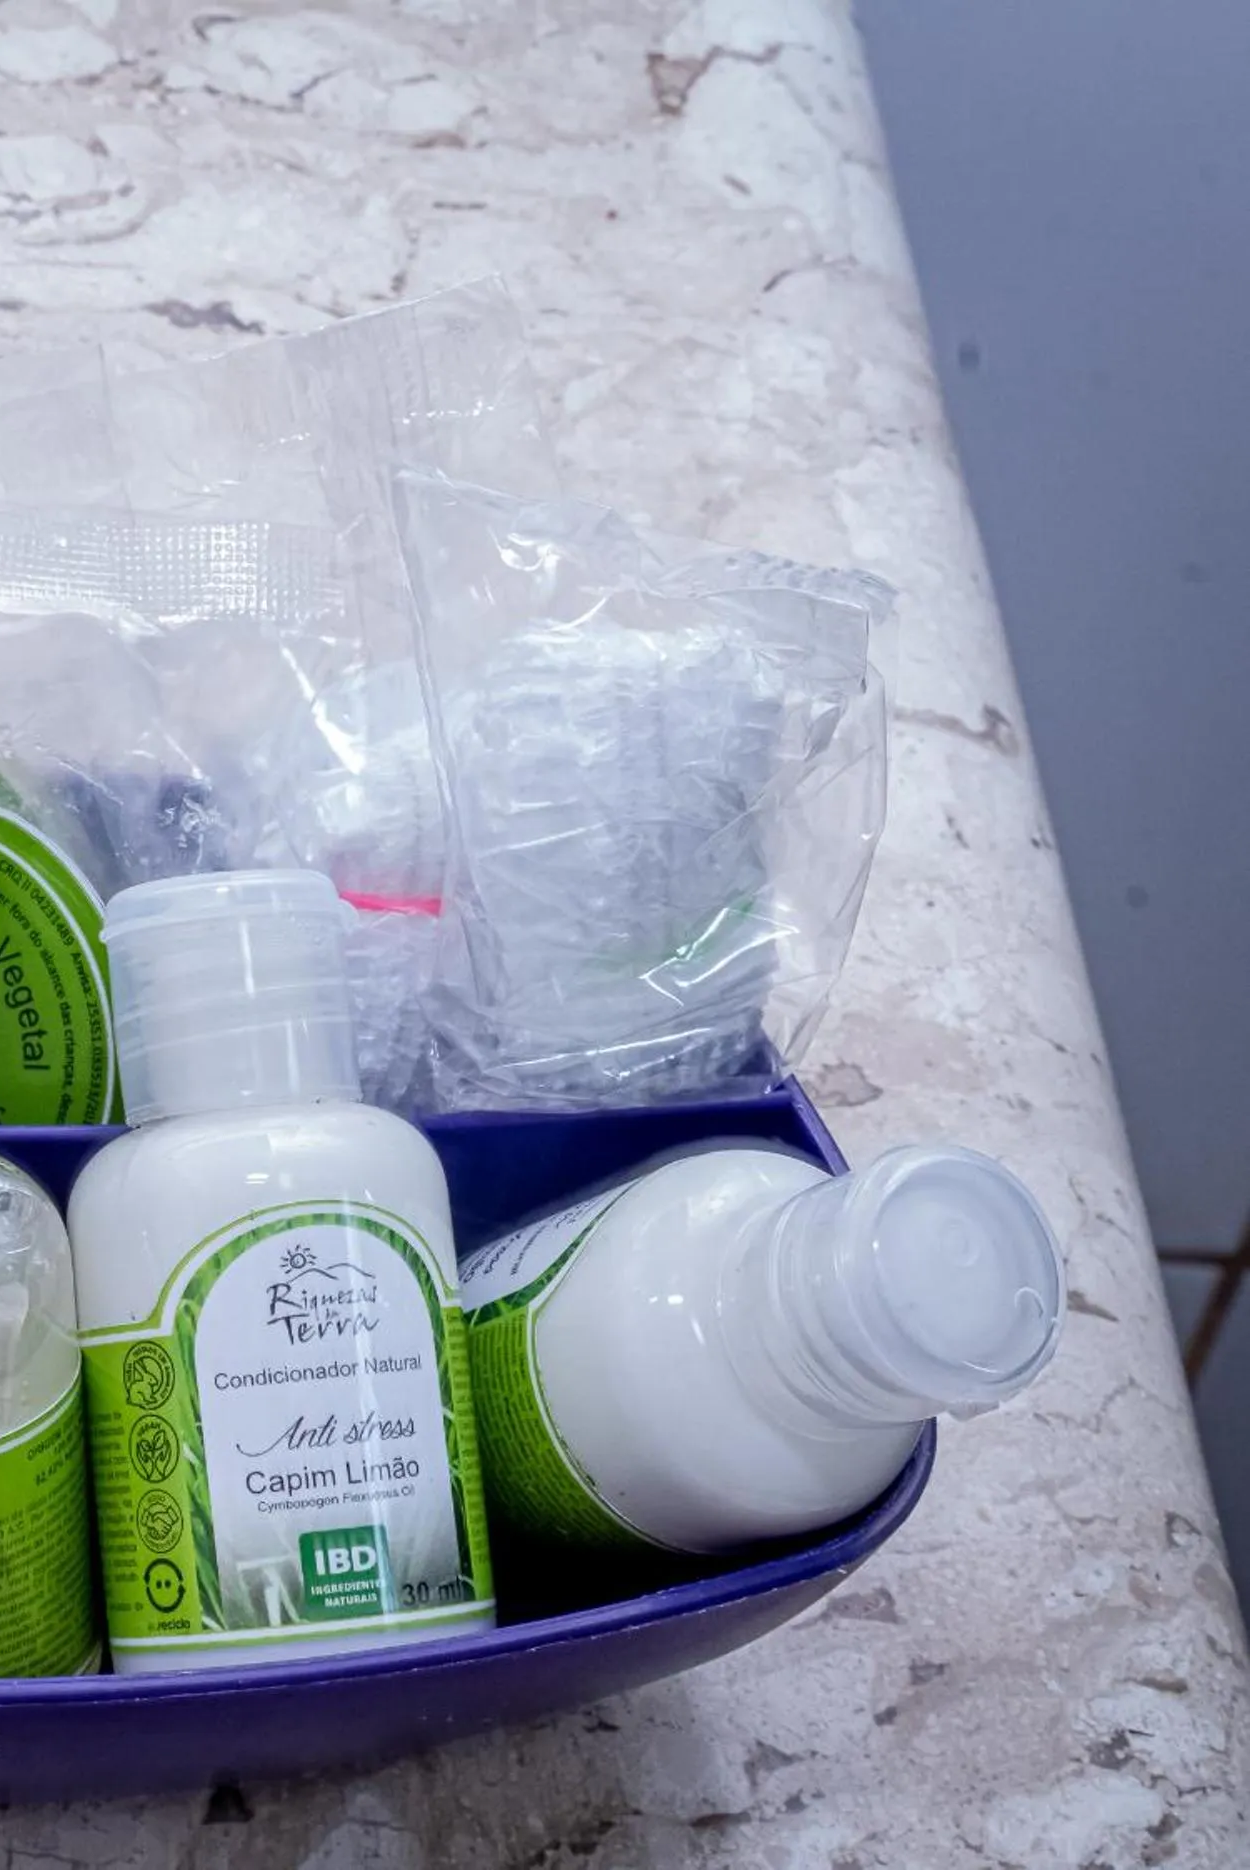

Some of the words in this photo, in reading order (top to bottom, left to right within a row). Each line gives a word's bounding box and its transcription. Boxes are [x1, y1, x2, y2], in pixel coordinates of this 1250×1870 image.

[266, 1282, 378, 1319] Riquezas
[267, 1312, 381, 1346] Terra
[213, 1360, 359, 1391] Condicionador
[363, 1354, 423, 1375] Natural
[236, 1413, 338, 1458] Anti
[343, 1409, 417, 1445] stress
[245, 1465, 337, 1498] Capim
[345, 1456, 421, 1486] Limão
[257, 1493, 340, 1514] Cymbopogon
[313, 1545, 378, 1577] IBD
[324, 1592, 378, 1608] NATURAIS
[402, 1580, 430, 1608] 30
[437, 1574, 464, 1601] ml
